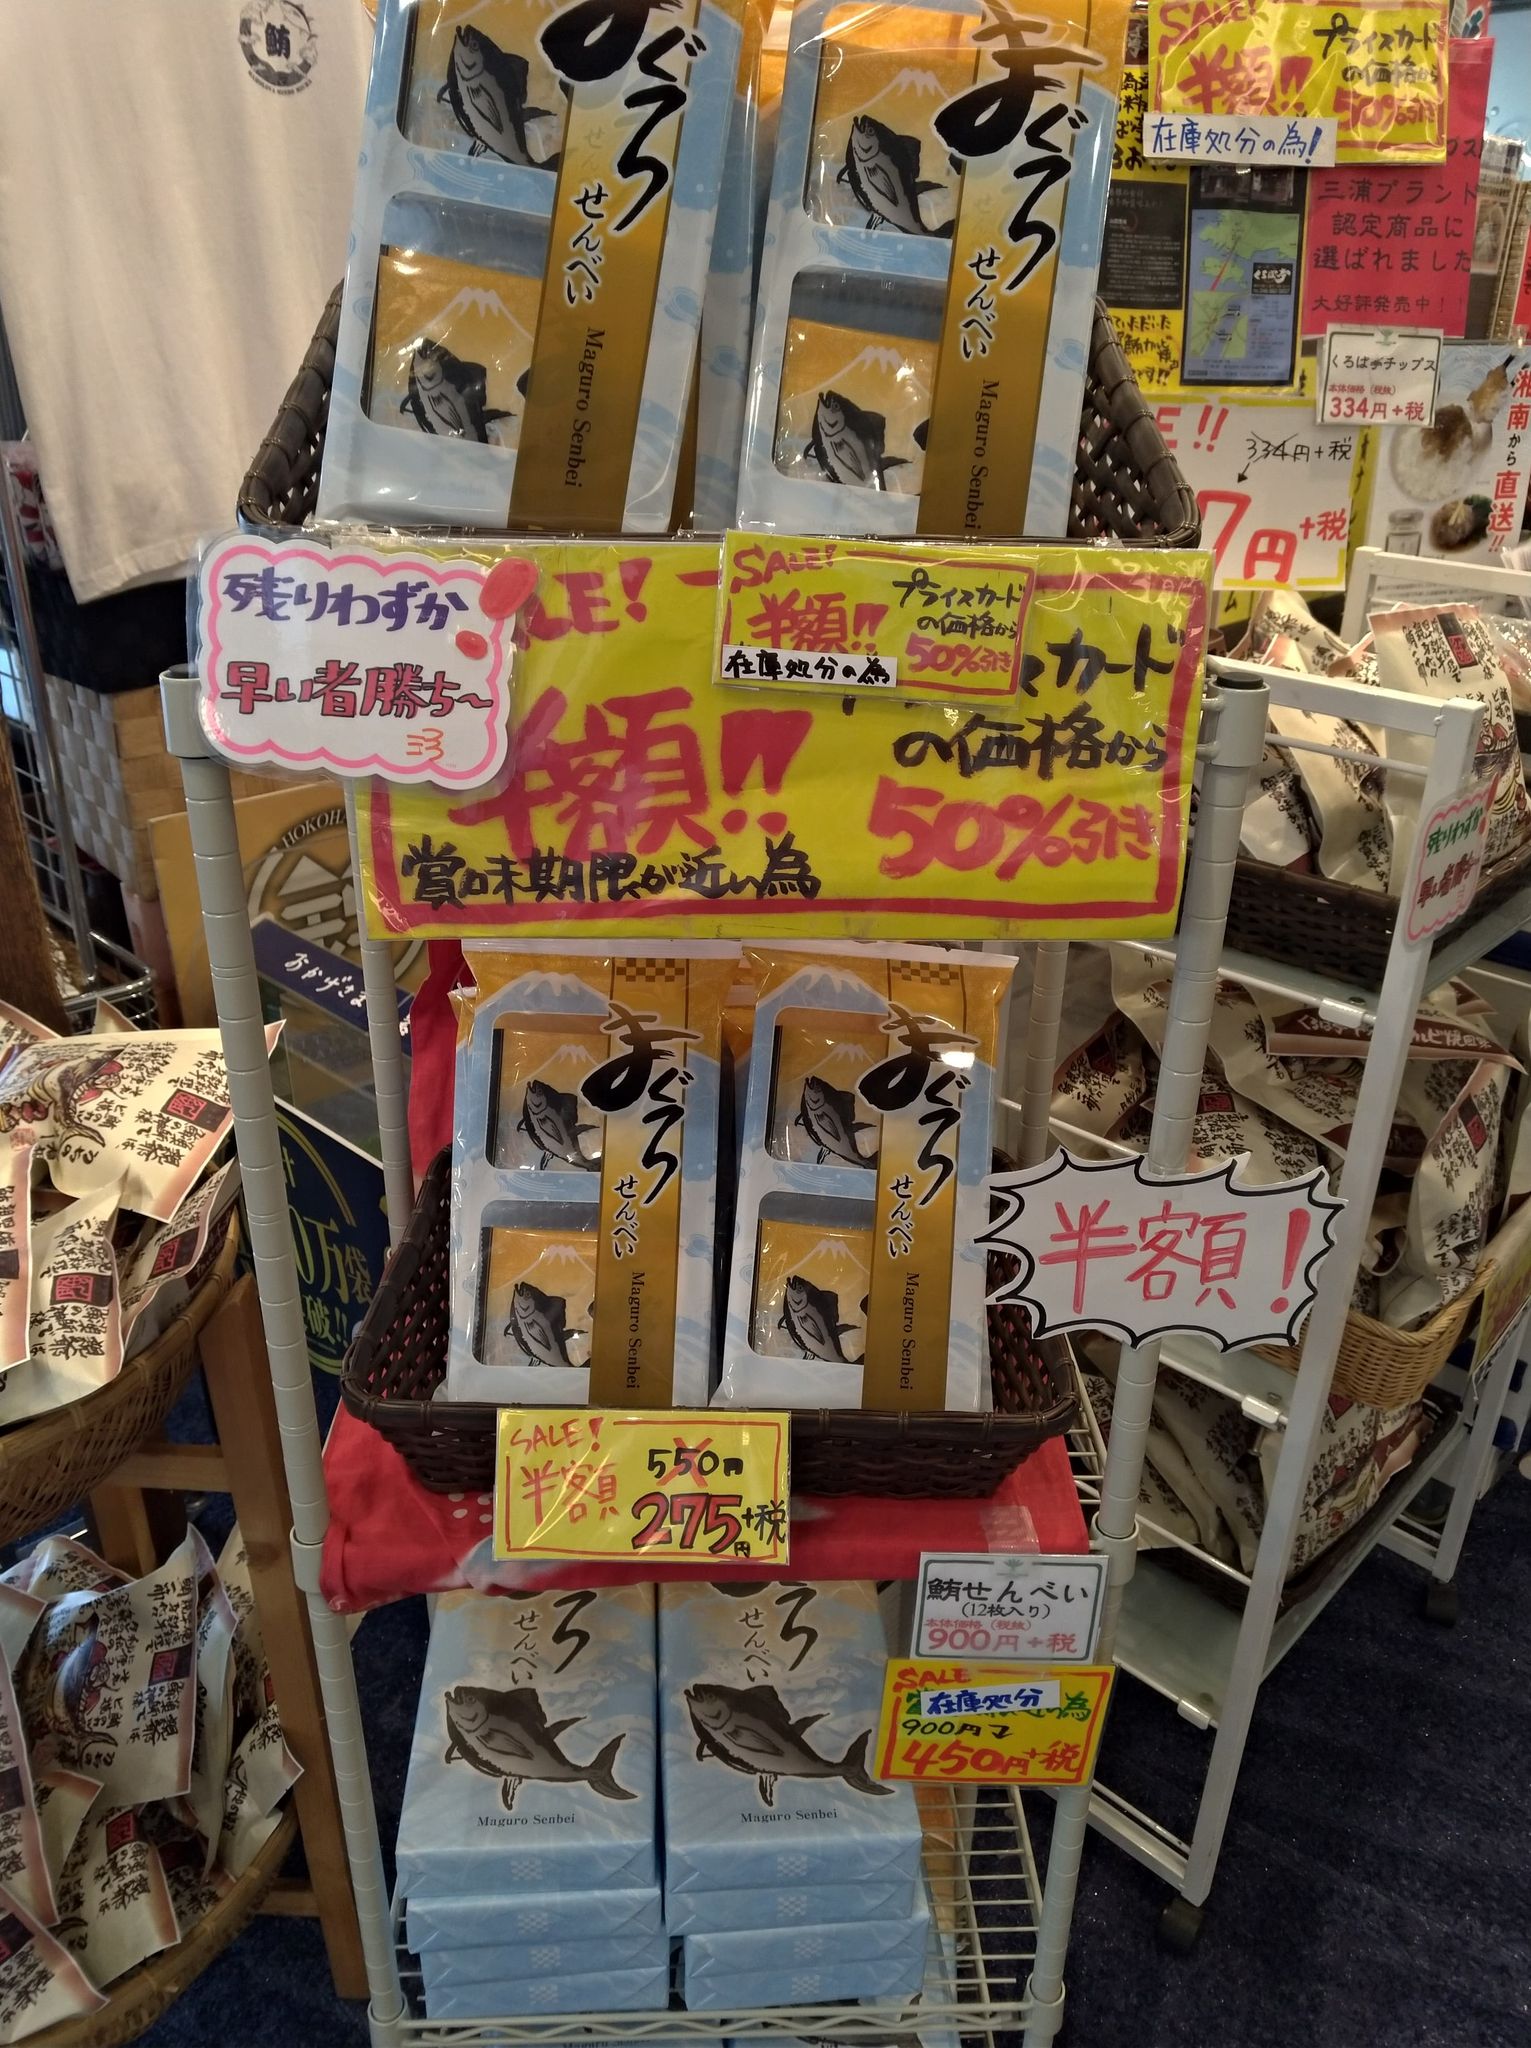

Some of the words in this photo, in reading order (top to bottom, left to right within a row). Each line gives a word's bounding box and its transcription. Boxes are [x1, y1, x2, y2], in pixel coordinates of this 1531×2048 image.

[1152, 117, 1322, 164] 在庫処分の為!
[566, 183, 609, 305] せんべい
[1313, 245, 1472, 272] 選ばれました
[1331, 212, 1464, 239] 認定商品に
[961, 247, 1001, 359] せんべい
[576, 326, 606, 412] Maguro
[974, 379, 1000, 459] Maguro
[564, 418, 592, 488] Senbei
[963, 464, 989, 530] Senbei
[222, 566, 470, 633] 残りわずか
[732, 543, 837, 594] SALE!
[892, 567, 1028, 609] プライスカード
[512, 557, 653, 651] LE!
[916, 610, 1019, 641] の価格から
[724, 651, 892, 686] 在庫処分の為
[904, 632, 1014, 676] 50%引き
[892, 702, 1168, 781] の価格から
[866, 774, 1161, 881] 50%引き
[401, 831, 822, 911] 賞味期限が近い為
[581, 1002, 701, 1205] まぐろ
[857, 1002, 980, 1206] まぐろ
[612, 1174, 639, 1258] せんべい
[888, 1173, 915, 1258] せんべい
[1038, 1199, 1311, 1315] 半額!
[628, 1270, 646, 1336] Maguro
[903, 1271, 920, 1336] Maguro
[625, 1337, 643, 1390] Senbei
[898, 1336, 916, 1391] Senbei
[510, 1417, 605, 1455] SALE!
[521, 1457, 621, 1527] 半額
[926, 1577, 1089, 1604] 鮪せんべい
[510, 1608, 540, 1688] せんべい
[738, 1607, 770, 1684] せんべい
[892, 1666, 973, 1693] SALE
[926, 1688, 1043, 1716] 在庫処分
[477, 1814, 530, 1828] Maguro
[532, 1812, 576, 1825] Senbei
[741, 1810, 792, 1824] Maguro
[794, 1808, 838, 1822] Senbei
